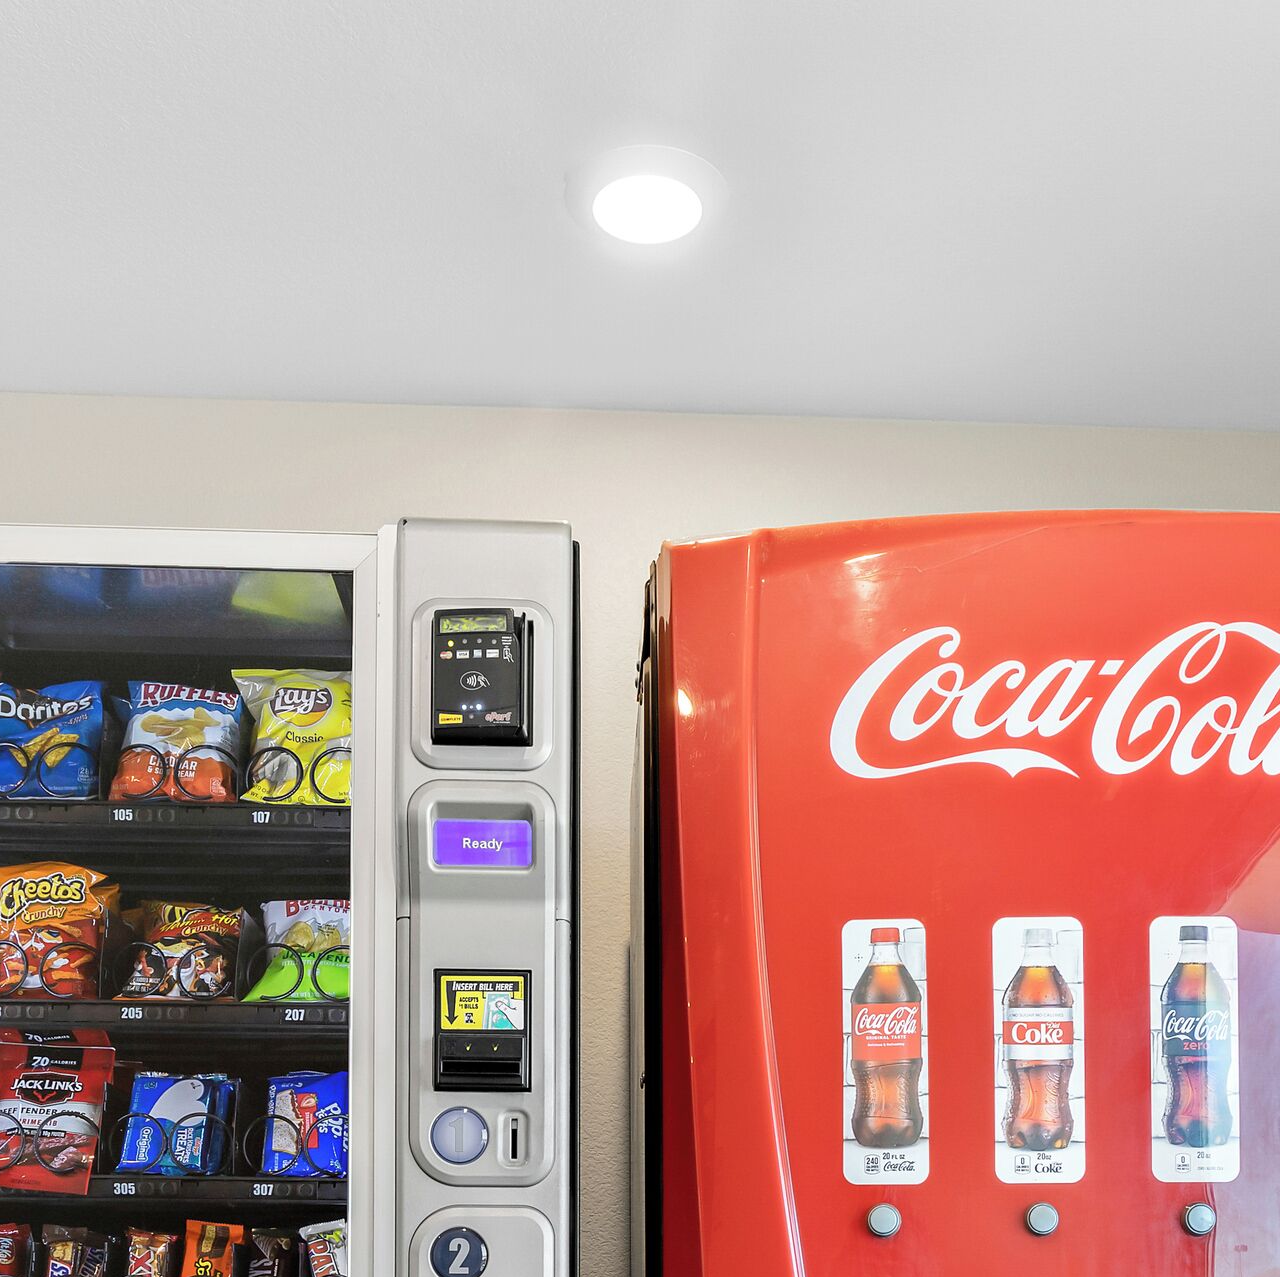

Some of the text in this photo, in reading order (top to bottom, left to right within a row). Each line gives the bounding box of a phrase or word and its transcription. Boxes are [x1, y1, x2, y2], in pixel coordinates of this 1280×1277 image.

[137, 681, 239, 711] RUFFLES
[275, 688, 328, 714] Lay's
[286, 730, 324, 744] Classic
[113, 809, 133, 821] 105
[252, 812, 270, 824] 107
[462, 837, 503, 853] Ready
[0, 873, 85, 921] Cheetos
[22, 906, 67, 923] Crunchy
[452, 981, 514, 992] INSERT BILL HERE
[121, 1007, 143, 1019] 205
[285, 1009, 305, 1020] 207
[855, 1006, 919, 1035] Coca-Cola
[1163, 1009, 1230, 1041] Coca-Cola
[1011, 1022, 1064, 1044] Coke
[1183, 1042, 1210, 1050] zero
[32, 1057, 50, 1067] 70
[11, 1078, 83, 1092] JACK LINK'S
[21, 1107, 57, 1115] TENDER
[448, 1116, 464, 1153] 1
[137, 1127, 152, 1161] Original
[174, 1129, 188, 1162] TREATS
[866, 1157, 879, 1165] 240
[883, 1160, 915, 1172] Coca-Cola
[1034, 1162, 1063, 1174] Coke
[113, 1183, 136, 1195] 305
[253, 1184, 274, 1196] 307
[448, 1237, 470, 1275] 2
